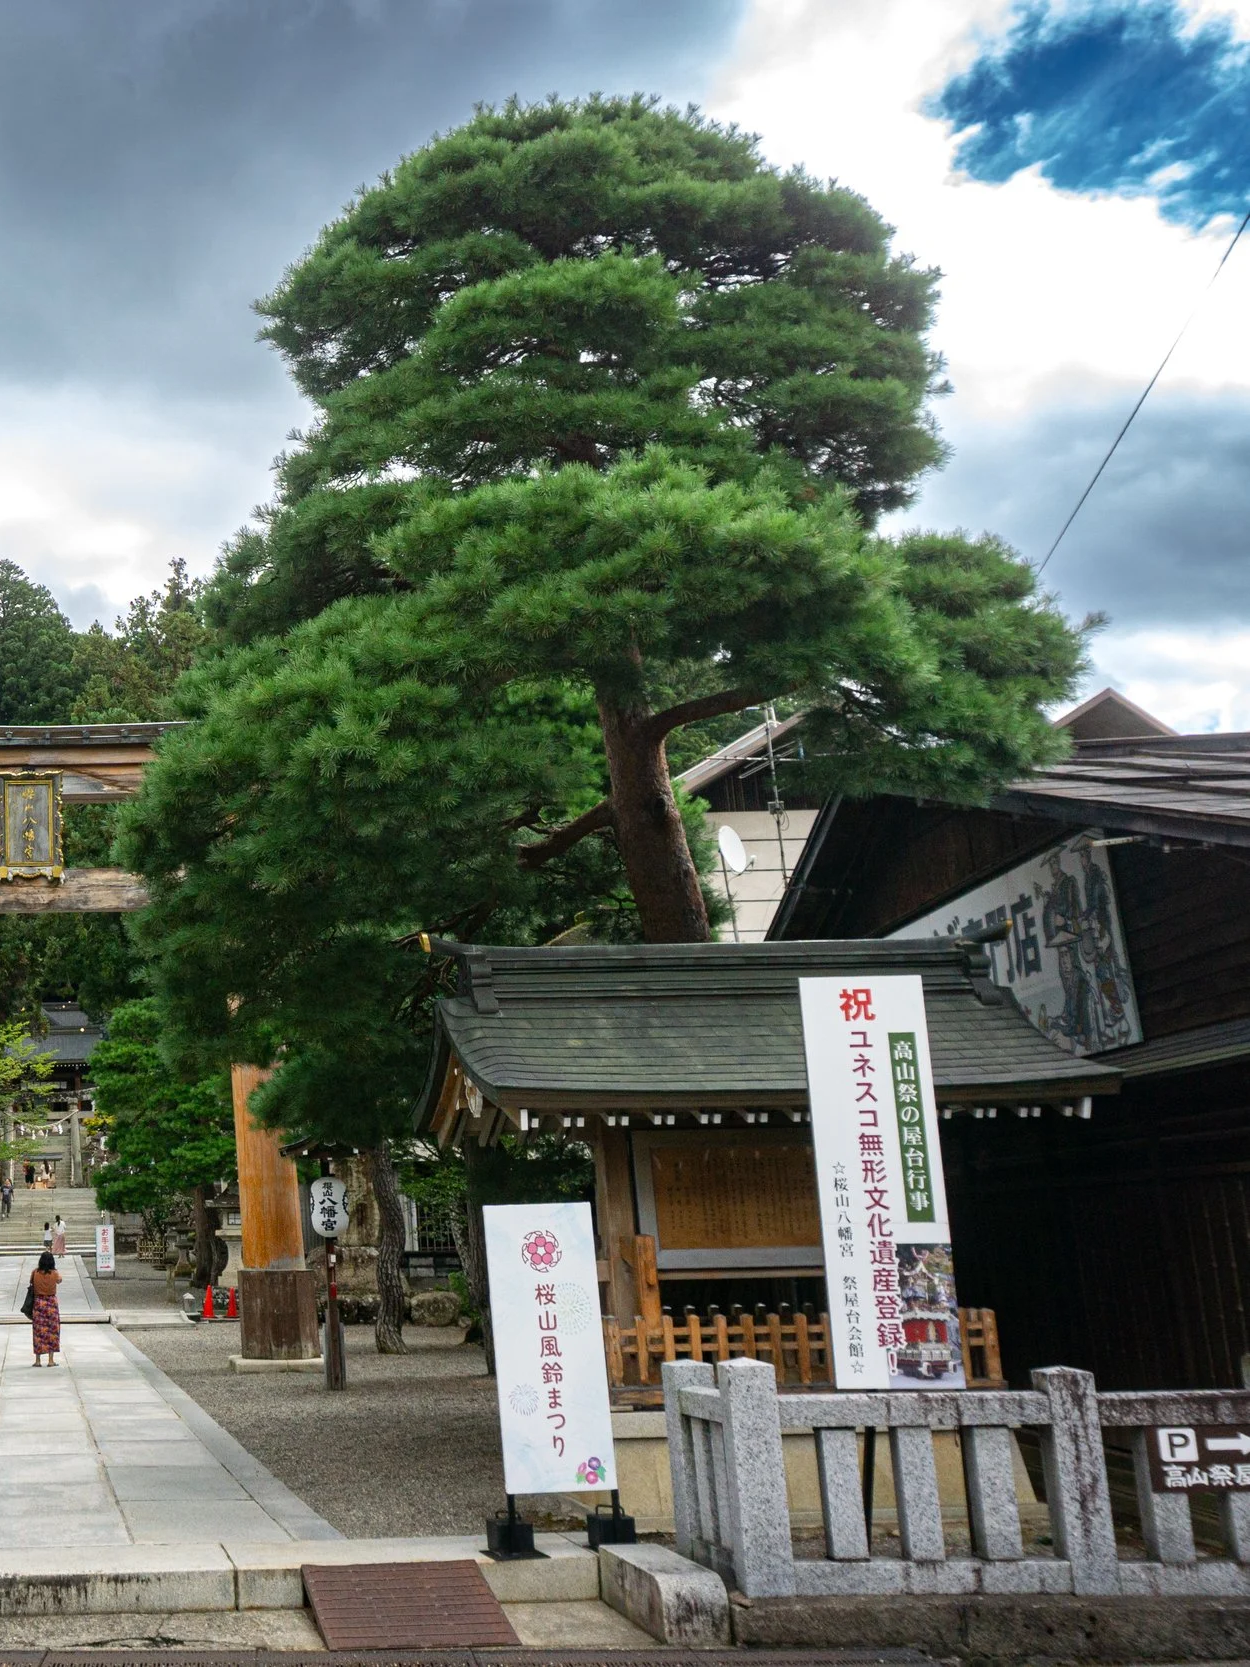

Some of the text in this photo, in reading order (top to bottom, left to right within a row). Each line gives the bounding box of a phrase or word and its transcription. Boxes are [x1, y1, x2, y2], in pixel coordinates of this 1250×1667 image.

[839, 988, 876, 1022] 祝
[893, 1040, 930, 1212] 高山祭の屋台行事
[833, 1177, 864, 1358] 桜山八幡宮 祭屋台会館
[535, 1283, 566, 1457] 桜山風鈴まつり
[1167, 1433, 1190, 1458] P
